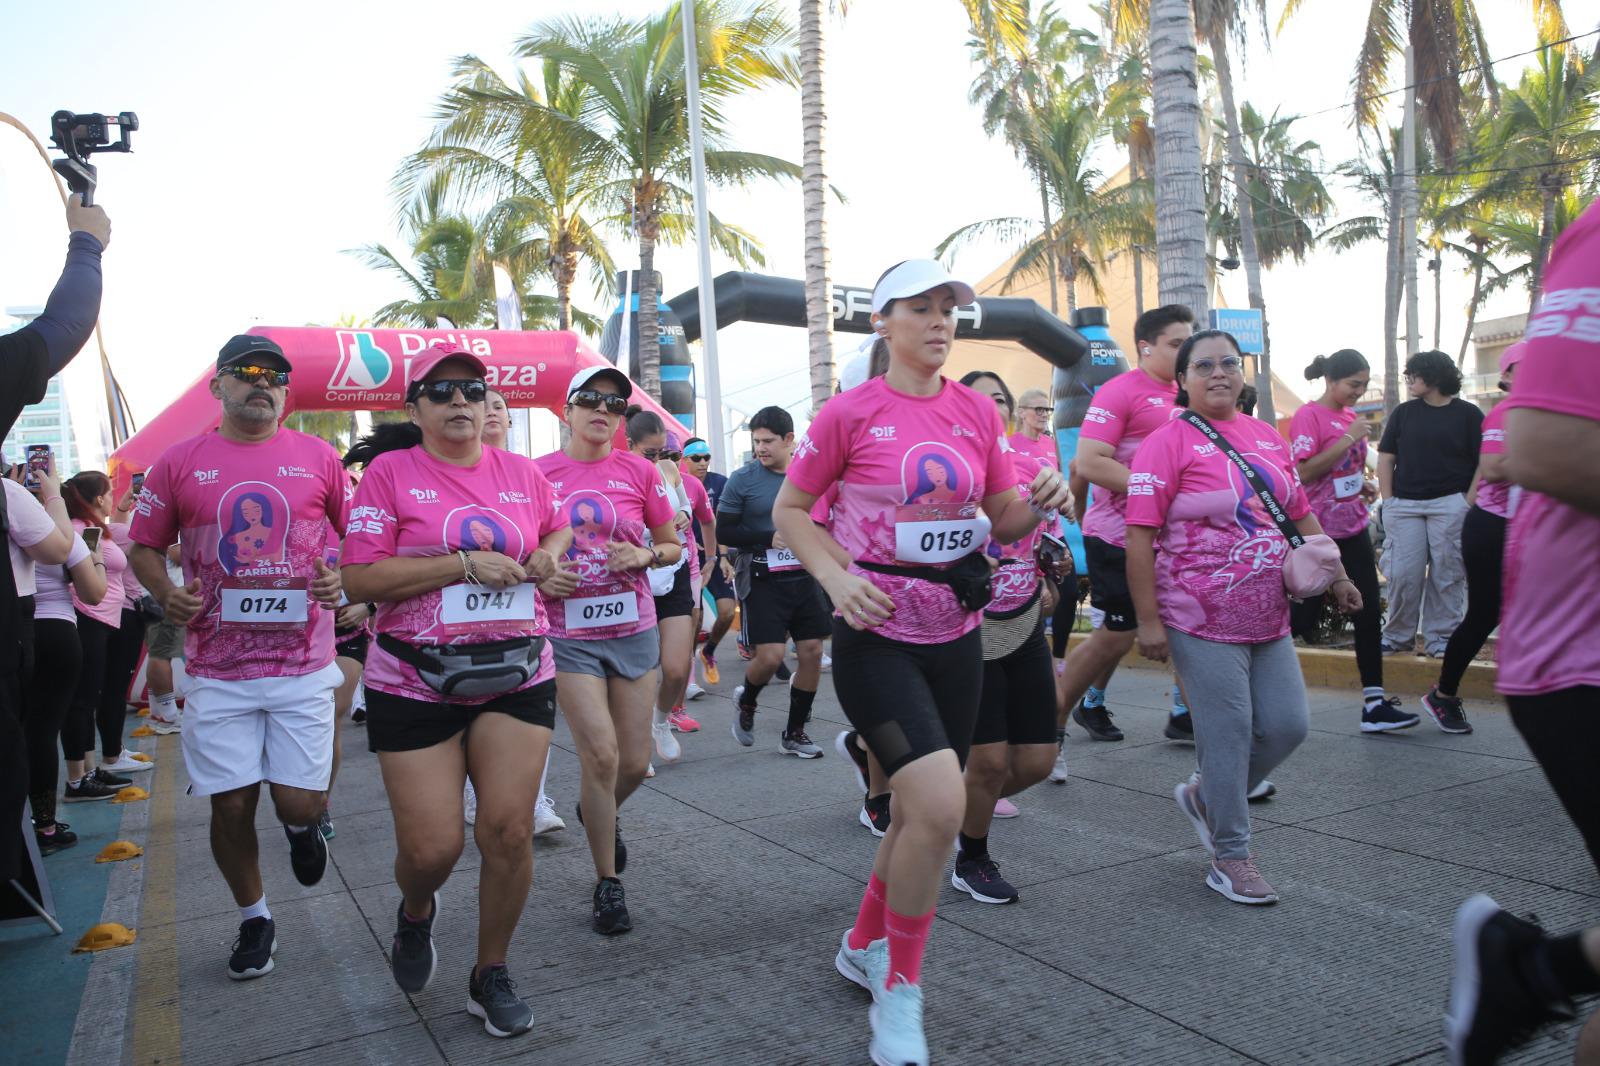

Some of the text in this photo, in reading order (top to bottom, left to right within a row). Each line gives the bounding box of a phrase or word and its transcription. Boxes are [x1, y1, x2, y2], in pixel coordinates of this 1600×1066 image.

[1221, 318, 1260, 331] DRIVE
[657, 335, 676, 345] DE
[1231, 330, 1260, 345] HRU
[325, 389, 535, 402] Confianza stico
[875, 426, 897, 438] DIF
[1189, 415, 1212, 434] REWIND
[1227, 449, 1248, 472] REWIND
[199, 469, 219, 481] DIF
[1260, 490, 1281, 515] REWIND
[921, 529, 974, 552] 0158
[236, 567, 289, 577] CARRERA
[240, 597, 288, 613] 0174
[465, 591, 516, 611] 0747
[583, 601, 625, 620] 0750
